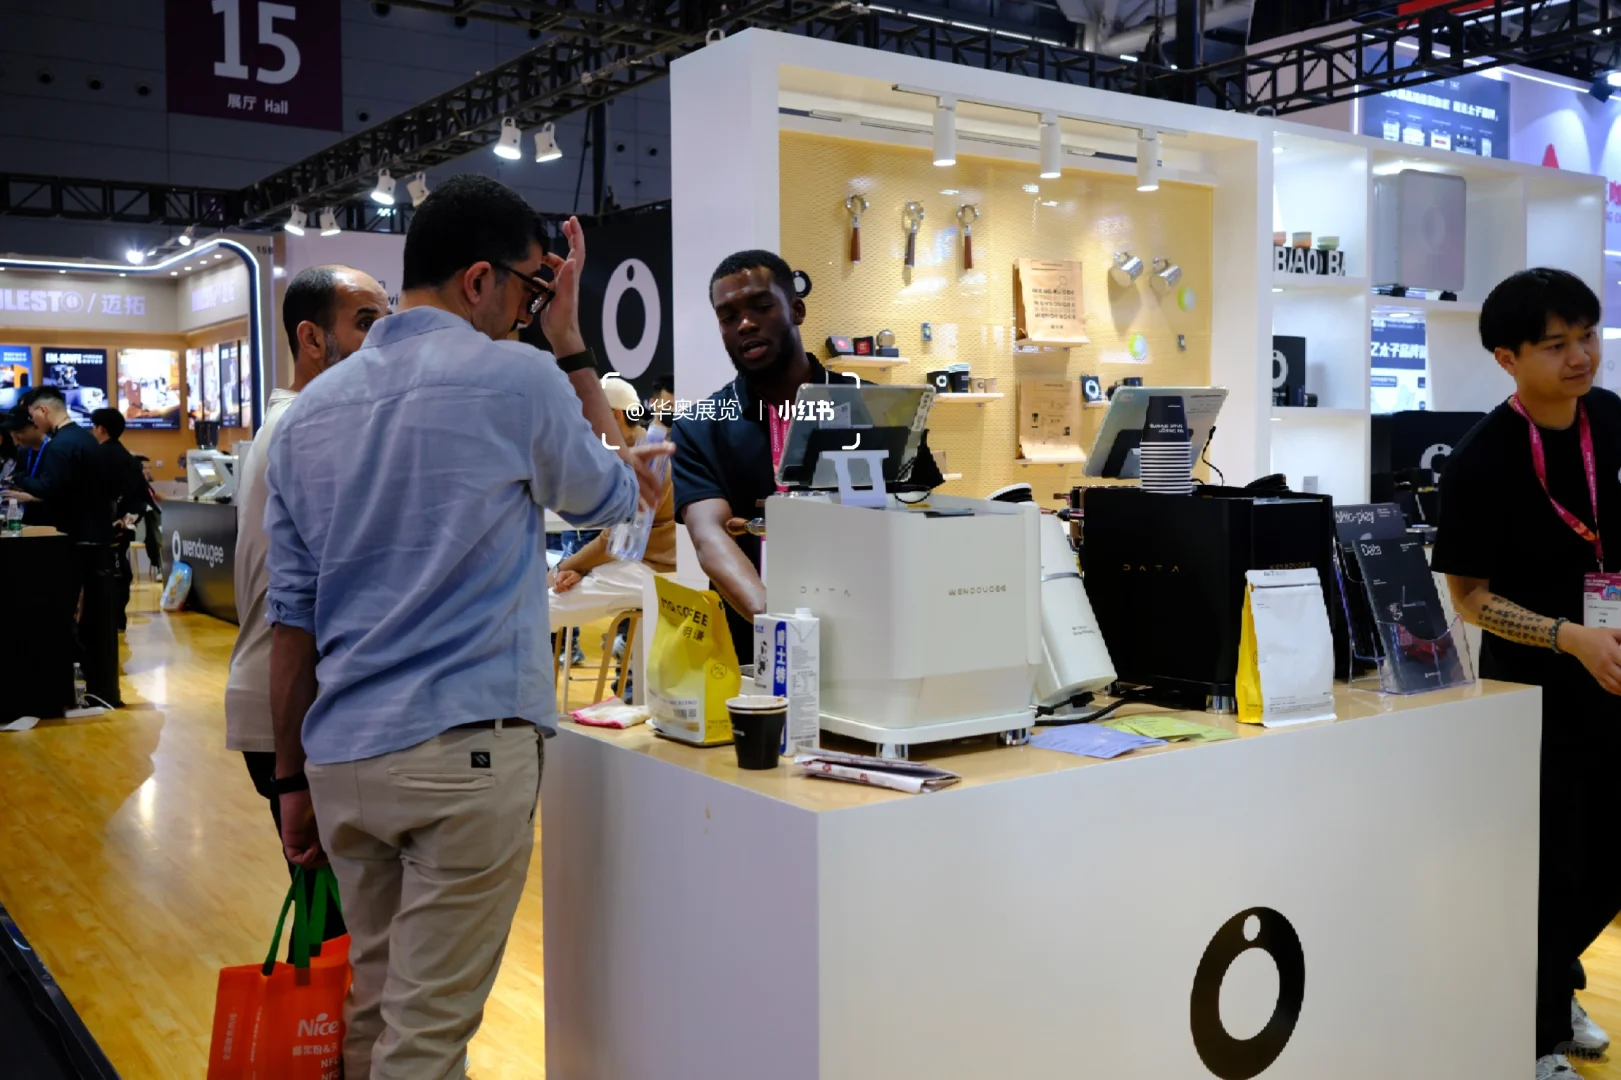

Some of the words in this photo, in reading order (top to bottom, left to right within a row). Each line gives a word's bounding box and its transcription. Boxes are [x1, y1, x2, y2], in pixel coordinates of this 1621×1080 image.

[211, 0, 301, 85] 15
[227, 93, 257, 110] 展厅
[264, 99, 289, 115] Hall
[101, 294, 146, 315] 迈拓
[182, 538, 224, 568] wendougee
[297, 1013, 340, 1037] Nice
